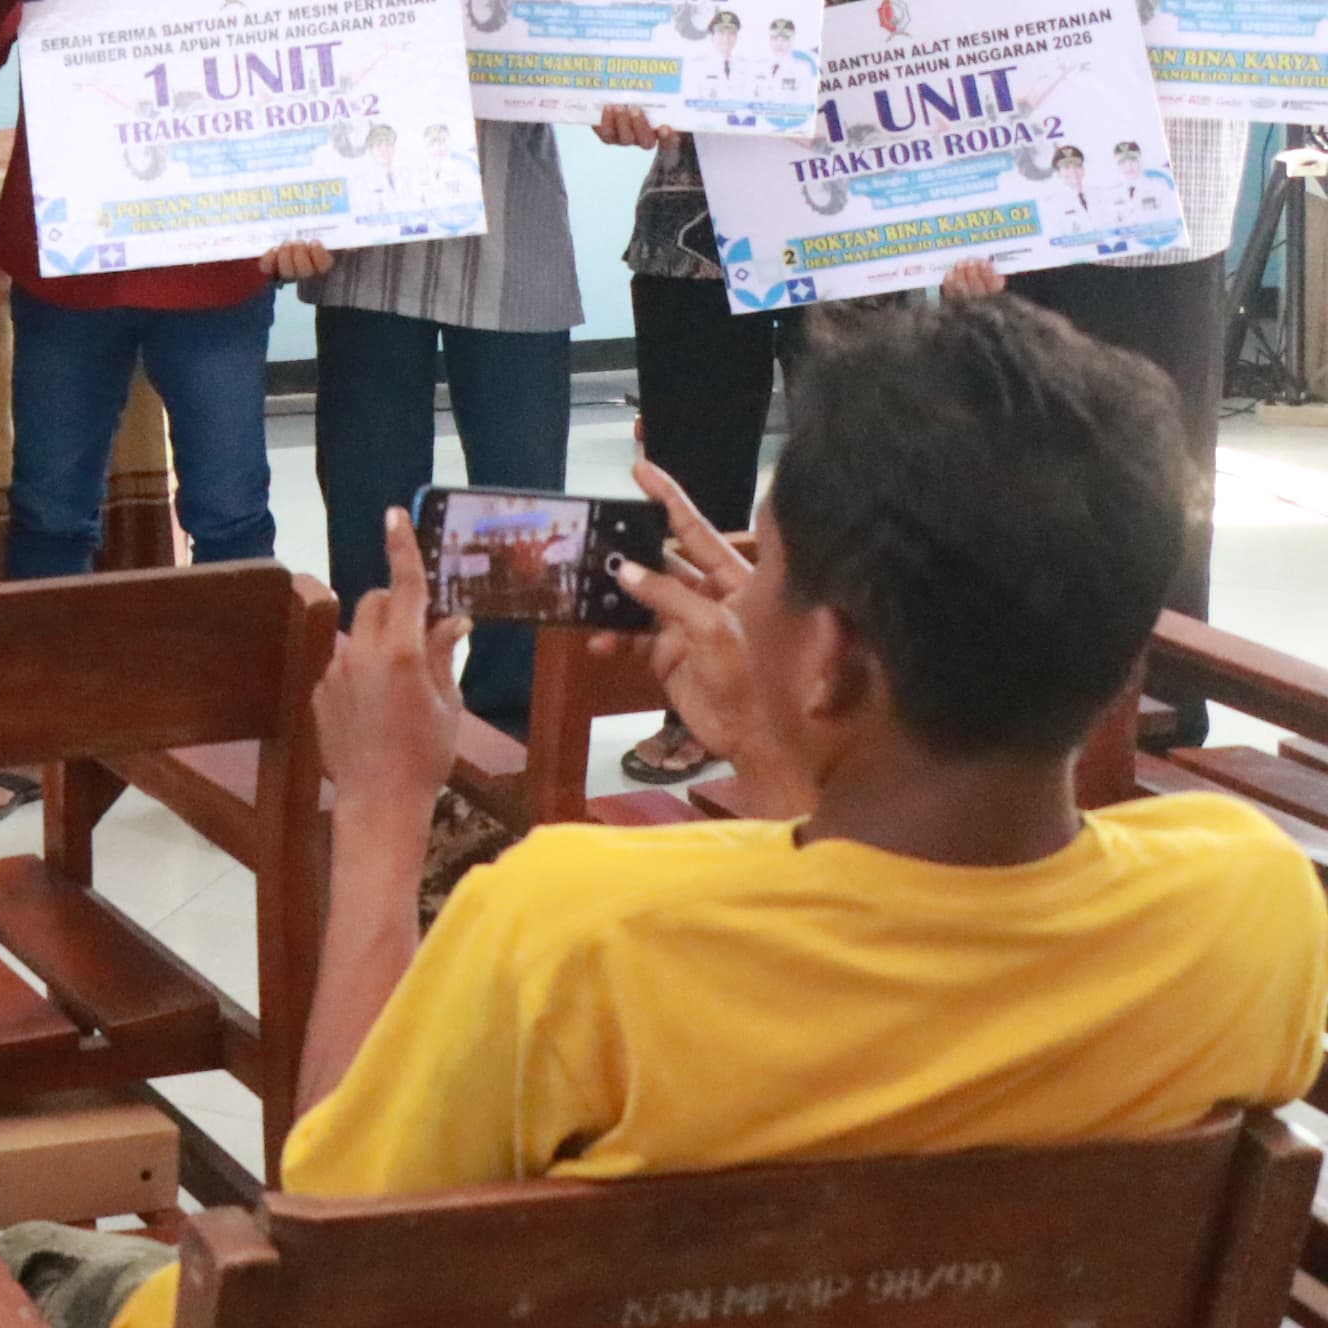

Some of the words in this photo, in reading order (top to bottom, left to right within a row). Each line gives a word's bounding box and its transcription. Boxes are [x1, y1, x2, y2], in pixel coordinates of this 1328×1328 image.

[827, 48, 905, 73] BANTUAN
[911, 38, 950, 57] ALAT
[956, 28, 1010, 48] MESIN
[1014, 8, 1113, 37] PERTANIAN
[1184, 50, 1237, 67] BINA
[1244, 52, 1320, 71] KARYA
[144, 64, 169, 107] 1
[203, 42, 341, 100] UNIT
[119, 110, 252, 145] TRAKTOR
[265, 98, 349, 127] RODA
[364, 94, 379, 115] 2
[814, 99, 843, 142] 1
[874, 66, 1016, 132] UNIT
[794, 139, 932, 181] TRAKTOR
[943, 122, 1033, 156] RODA
[1047, 117, 1063, 138] 2
[782, 249, 797, 265] 2
[802, 228, 881, 254] POKTAN
[884, 220, 932, 241] BINA
[937, 209, 1004, 232] KARYA
